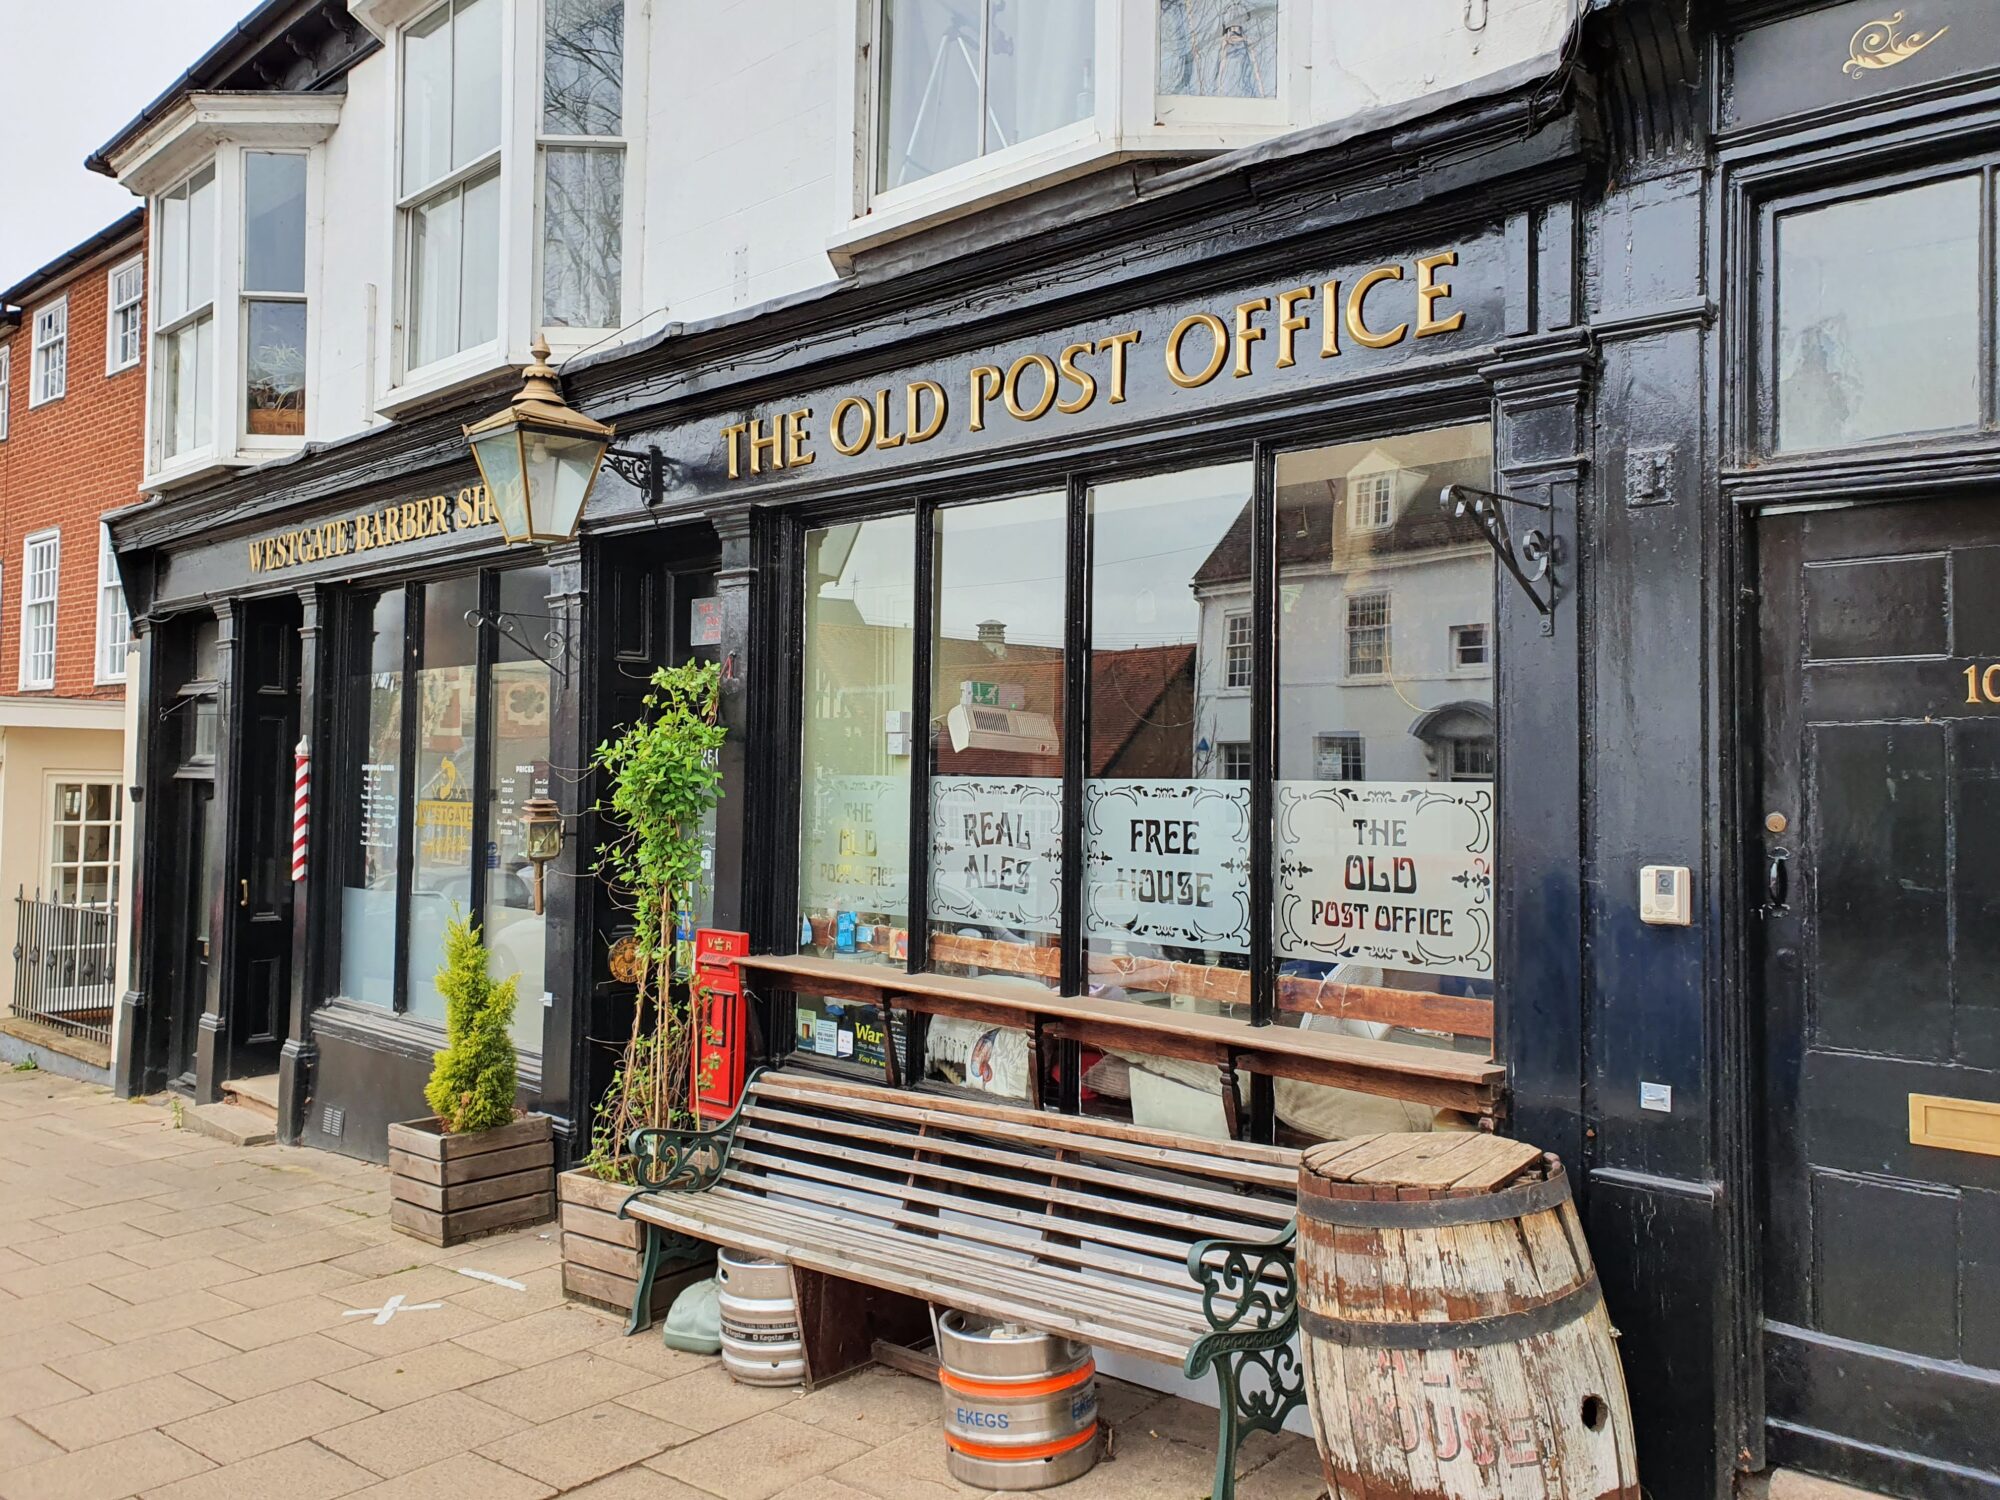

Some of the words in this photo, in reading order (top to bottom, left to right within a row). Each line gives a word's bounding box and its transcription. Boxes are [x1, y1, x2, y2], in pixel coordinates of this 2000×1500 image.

[720, 407, 816, 479] THE
[829, 380, 945, 456] OLD
[969, 330, 1142, 432] POST
[1164, 251, 1466, 388] OFFICE
[249, 518, 349, 573] WESTGATE
[355, 495, 449, 551] BARBER
[457, 484, 500, 529] SH
[1962, 663, 2000, 703] 10
[515, 765, 535, 774] PRICES
[844, 801, 873, 823] THE
[963, 812, 1031, 850] REAL
[1130, 819, 1200, 856] FREE
[1352, 818, 1408, 847] THE
[820, 863, 852, 885] POS
[964, 854, 1031, 894] ALES
[1116, 868, 1214, 908] HOUSE
[1344, 854, 1417, 894] OLD
[1311, 899, 1369, 930] POST
[1374, 905, 1454, 937] OFFICE
[759, 1333, 785, 1342] Kegstar
[957, 1407, 1009, 1429] EKEGS
